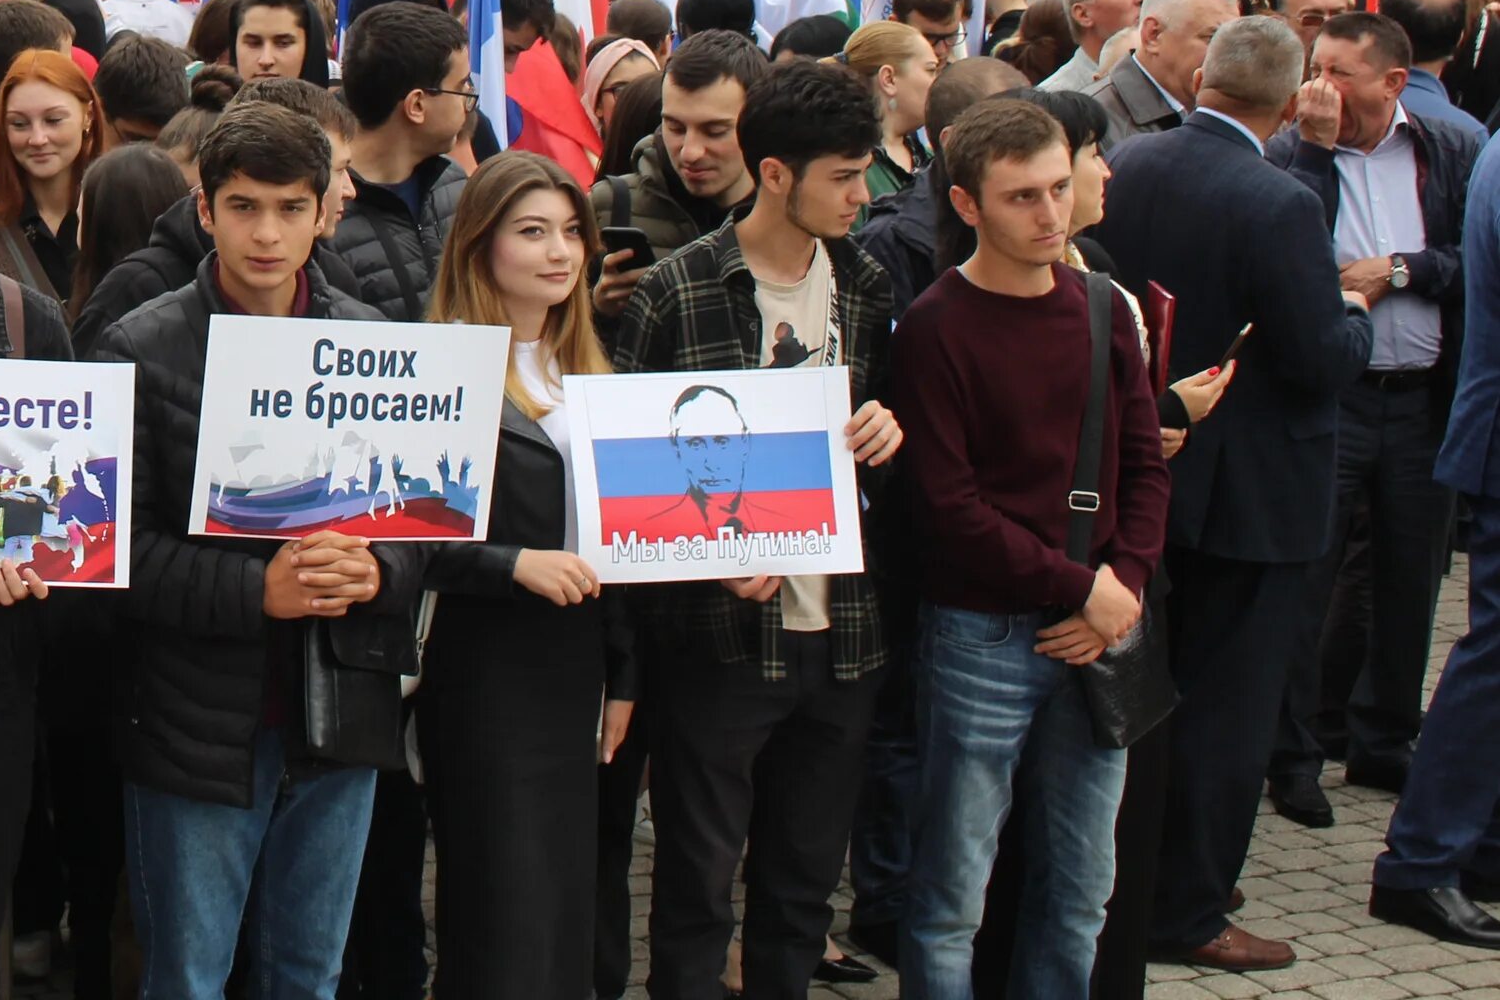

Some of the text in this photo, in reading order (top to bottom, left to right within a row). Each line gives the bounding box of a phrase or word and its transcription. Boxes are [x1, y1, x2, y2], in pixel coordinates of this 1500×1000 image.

[312, 338, 418, 378] Своих
[249, 380, 464, 429] не бросаем!
[611, 521, 832, 566] Мы за Путина!
